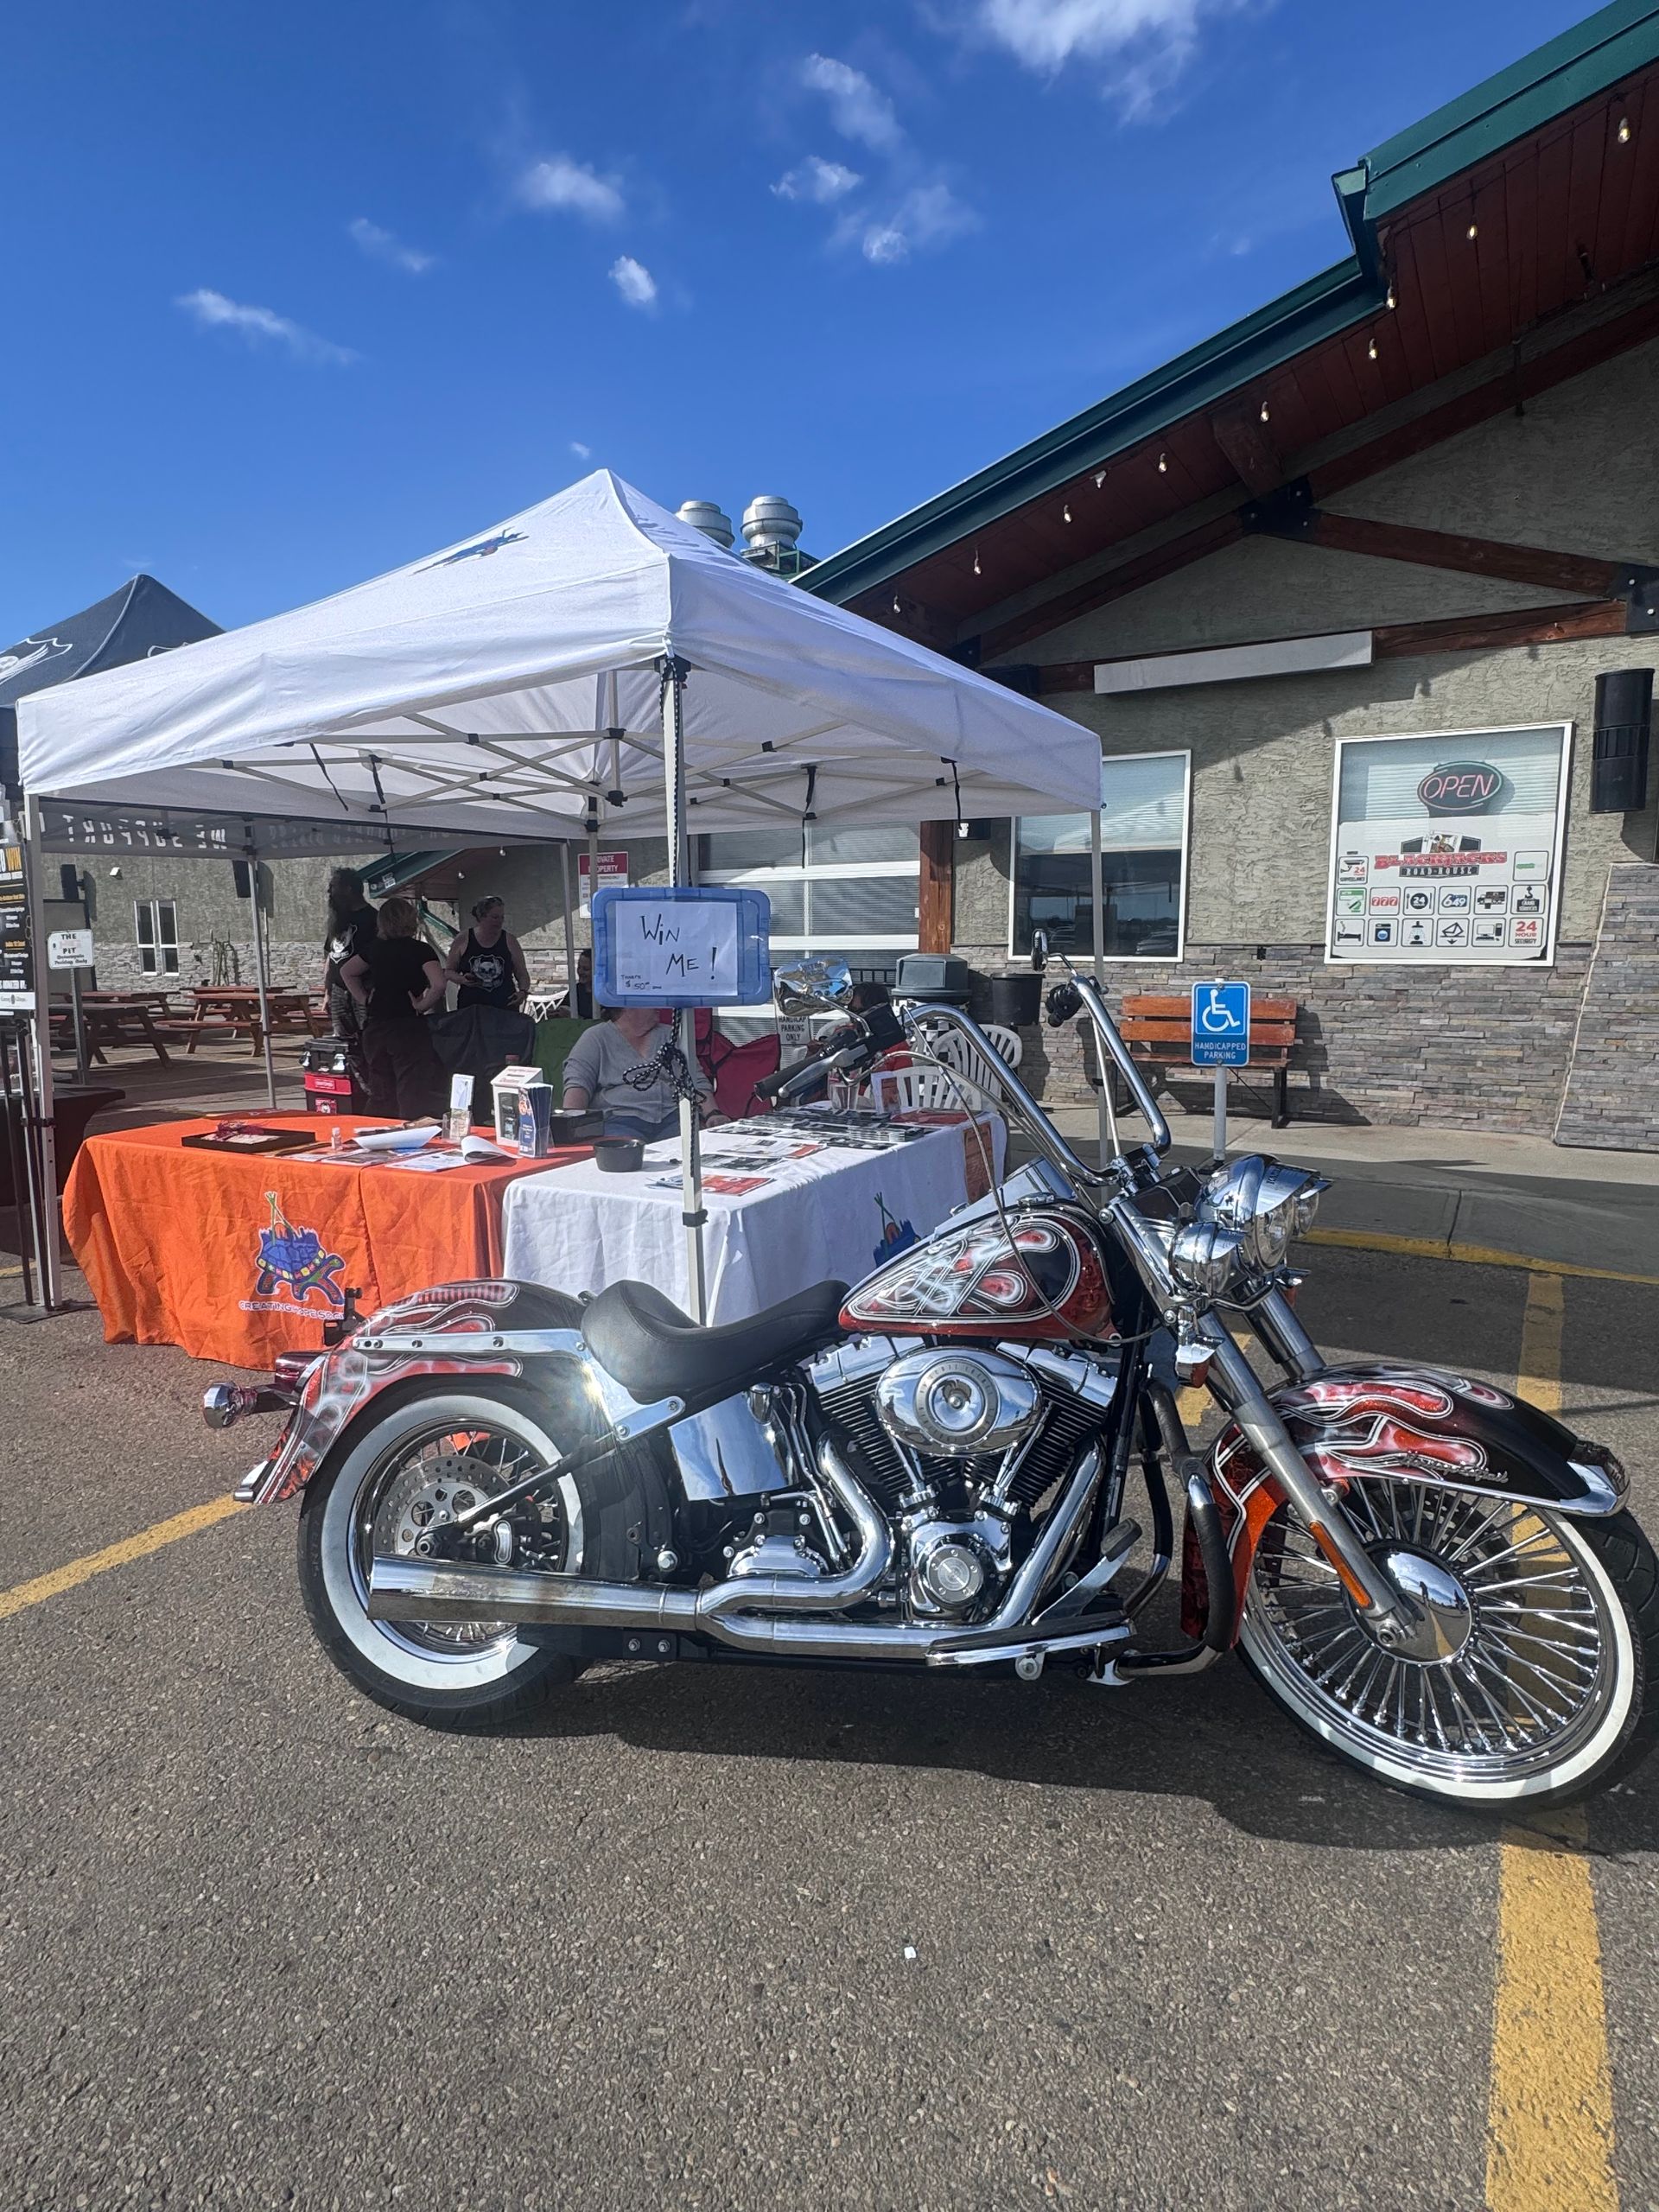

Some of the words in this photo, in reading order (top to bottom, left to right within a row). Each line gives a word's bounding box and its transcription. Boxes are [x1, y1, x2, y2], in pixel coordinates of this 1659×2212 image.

[1423, 773, 1495, 799] OPEN
[1375, 851, 1508, 869] BLACKJACKS
[1516, 920, 1537, 931] 24
[1194, 1042, 1246, 1051] HANDICAPPED
[238, 1300, 292, 1313] CREATING
